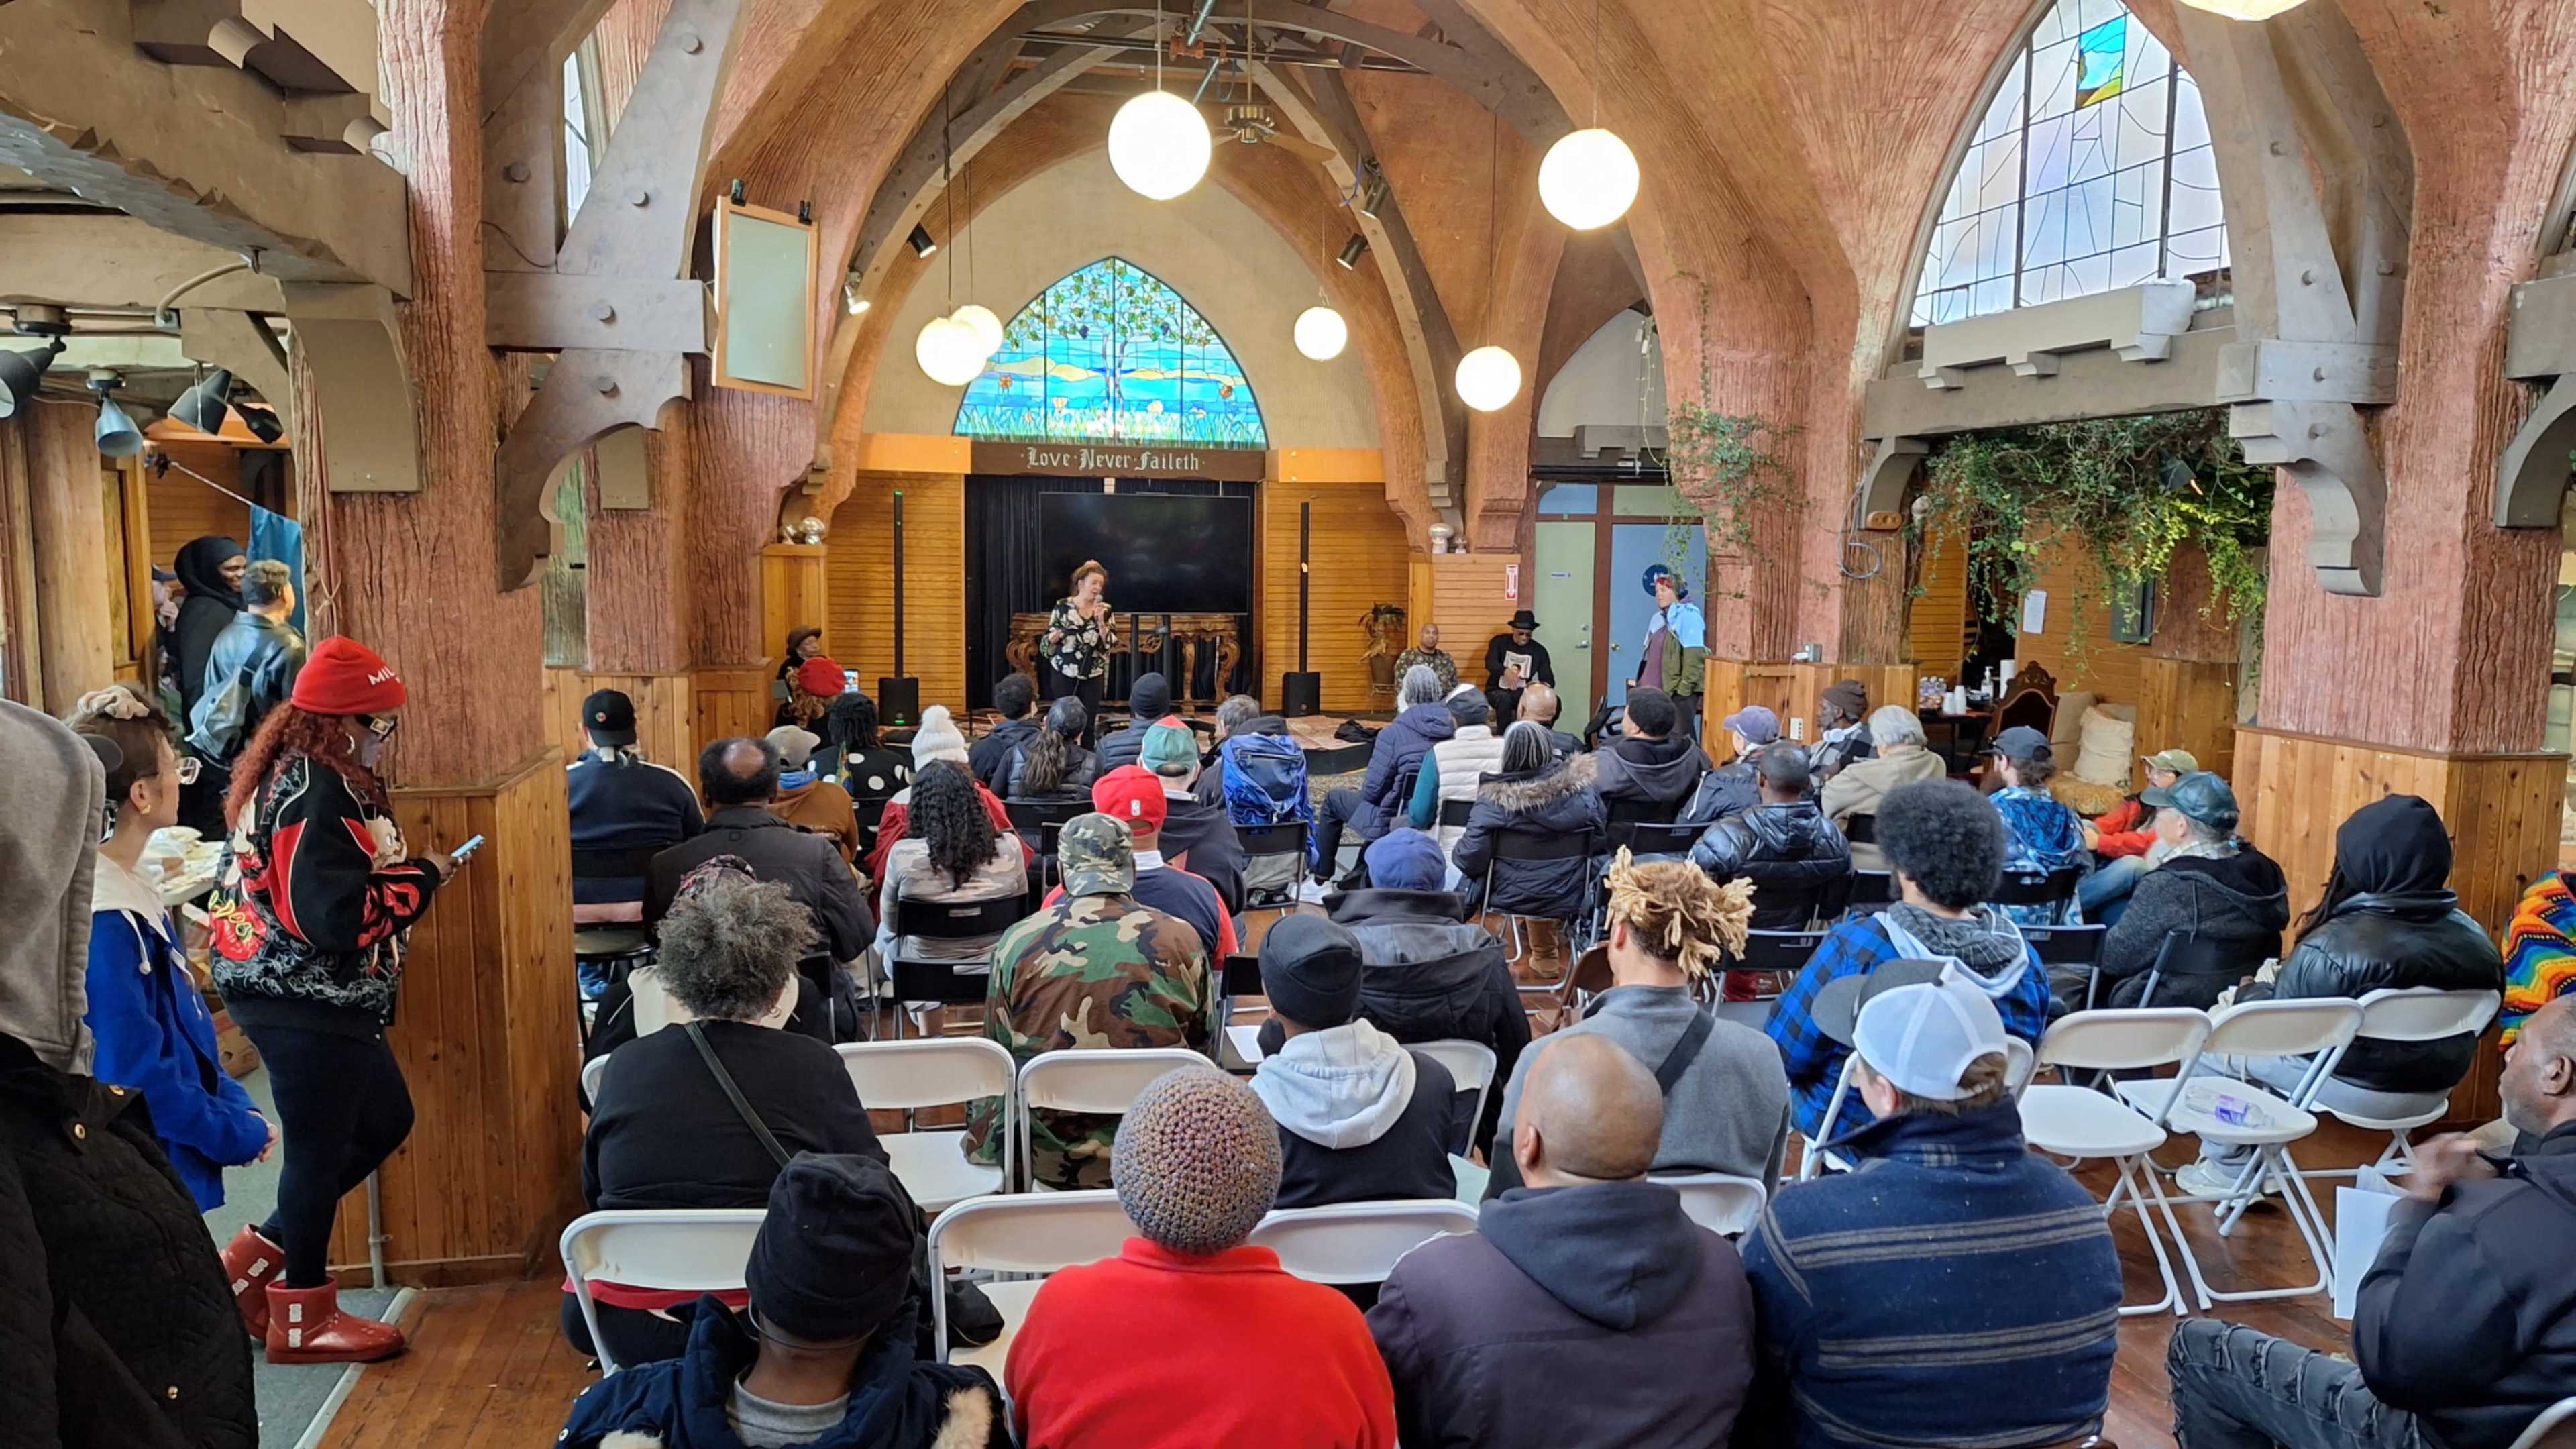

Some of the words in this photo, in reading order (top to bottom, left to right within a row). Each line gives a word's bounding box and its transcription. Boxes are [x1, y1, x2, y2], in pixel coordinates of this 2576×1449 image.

[1027, 447, 1071, 468] Love
[1079, 448, 1130, 470] Never
[1134, 451, 1199, 471] Faileth
